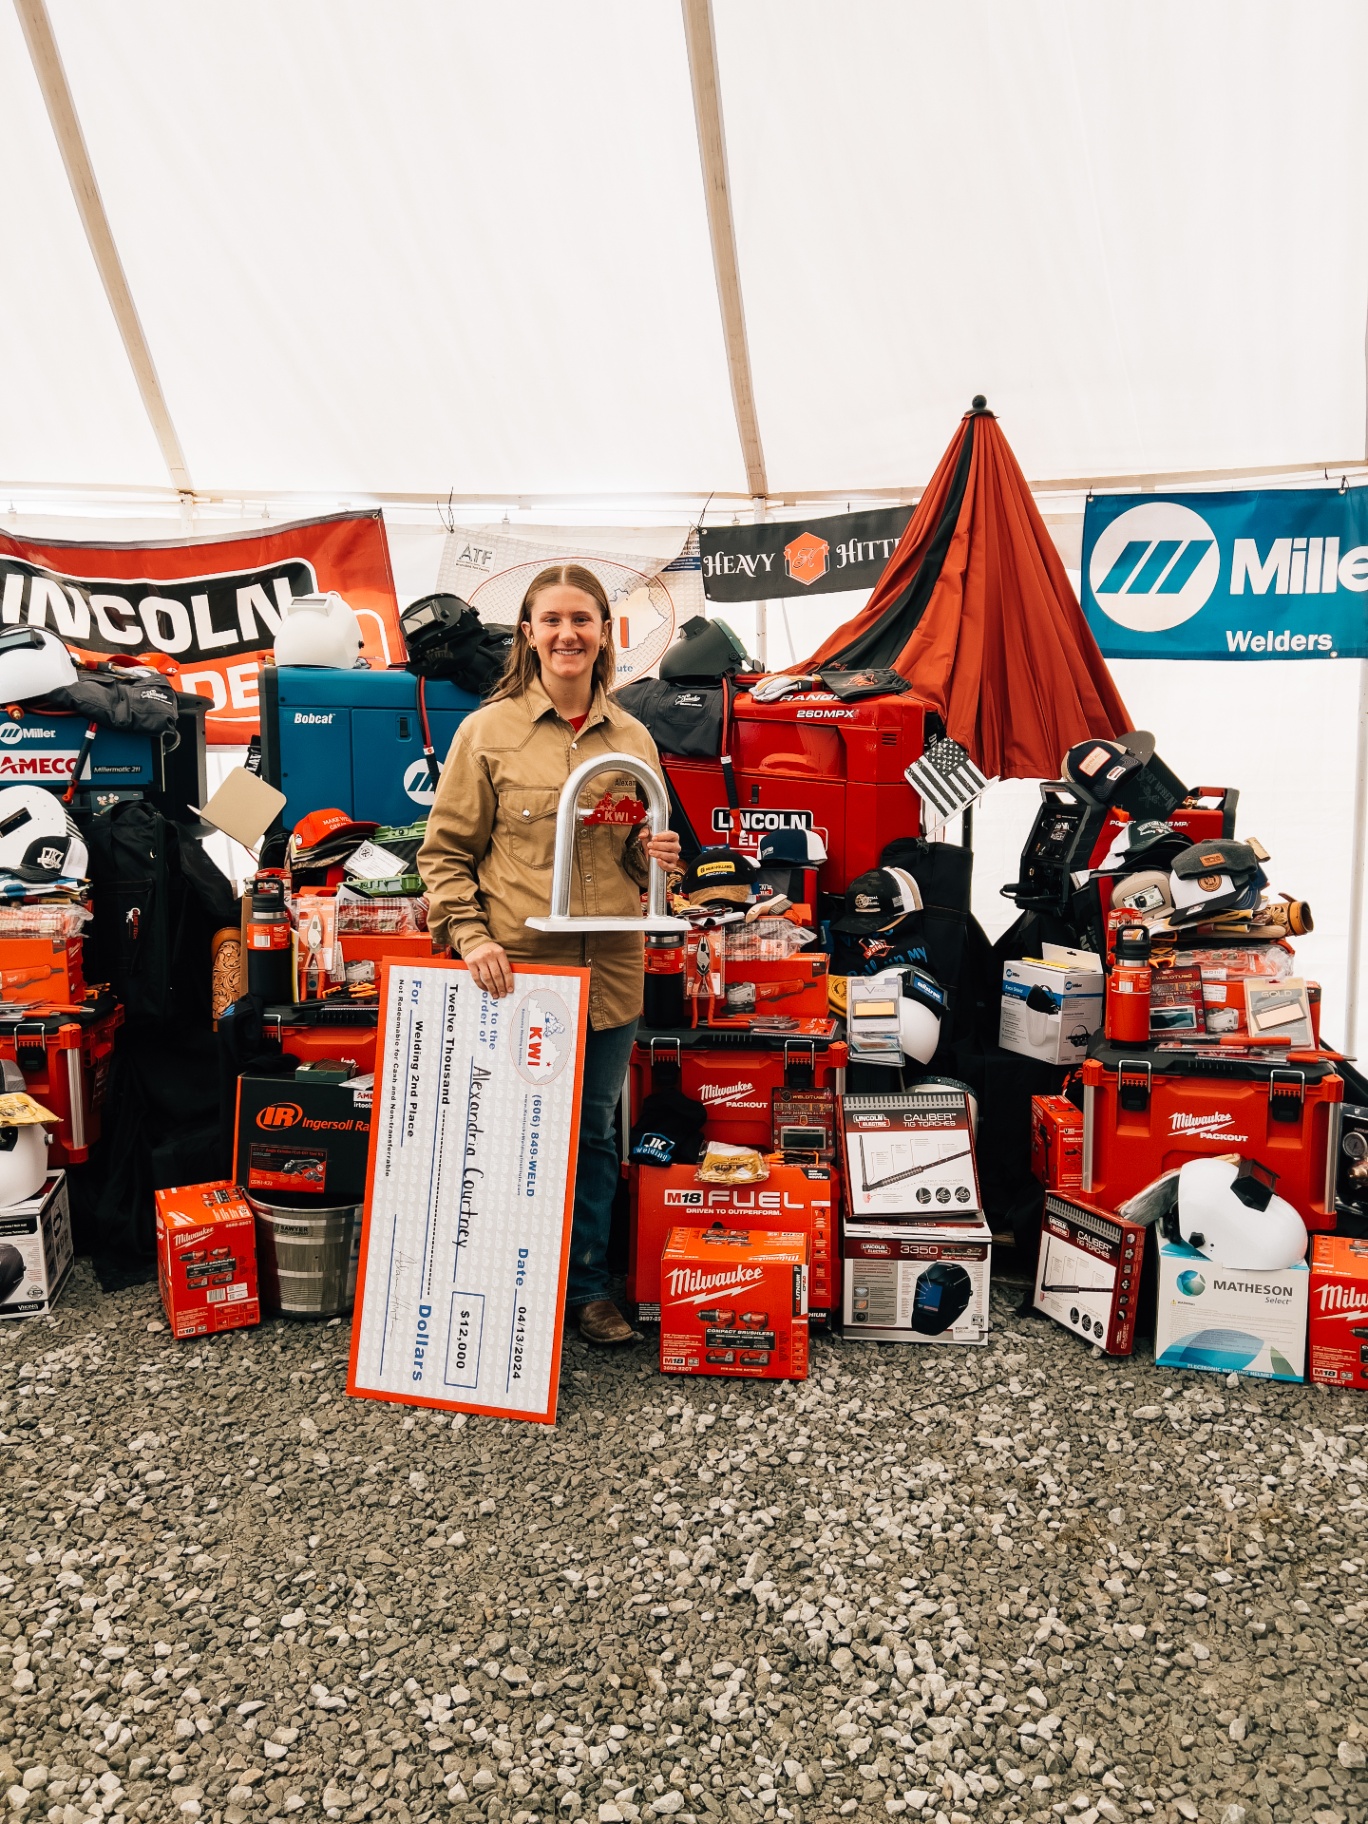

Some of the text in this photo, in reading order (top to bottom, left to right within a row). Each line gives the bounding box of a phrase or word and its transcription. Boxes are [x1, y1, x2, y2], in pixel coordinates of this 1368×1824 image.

[458, 543, 492, 565] ATF
[702, 551, 776, 578] HEAVY
[1226, 630, 1333, 652] Welders
[294, 713, 334, 724] Bobcat
[23, 728, 56, 738] Miller
[604, 811, 629, 822] KWI
[395, 996, 404, 1045] Redeemable
[490, 1015, 499, 1028] to
[441, 983, 459, 1105] Twelve Thousand
[479, 1029, 486, 1043] of
[488, 1031, 498, 1050] the
[527, 1026, 543, 1066] KWI
[407, 980, 424, 1138] For Welding 2nd Place
[262, 1107, 295, 1127] IR
[302, 1117, 353, 1131] Ingersoll
[526, 1094, 543, 1197] (606) 849-WELD
[1200, 1132, 1249, 1142] PACKOUT
[452, 1065, 492, 1248] Alexandria Courtney
[666, 1193, 702, 1204] M18
[708, 1190, 805, 1209] FUEL
[901, 1246, 938, 1255] 3350
[516, 1248, 528, 1287] Date
[664, 1265, 763, 1297] Milwaukee
[1213, 1280, 1293, 1297] MATHESON
[1265, 1297, 1289, 1305] Select
[412, 1304, 432, 1382] Dollars
[456, 1310, 470, 1370] $12,000
[512, 1306, 527, 1380] 04/13/2024
[663, 1357, 684, 1365] M18
[1314, 1368, 1336, 1377] M18
